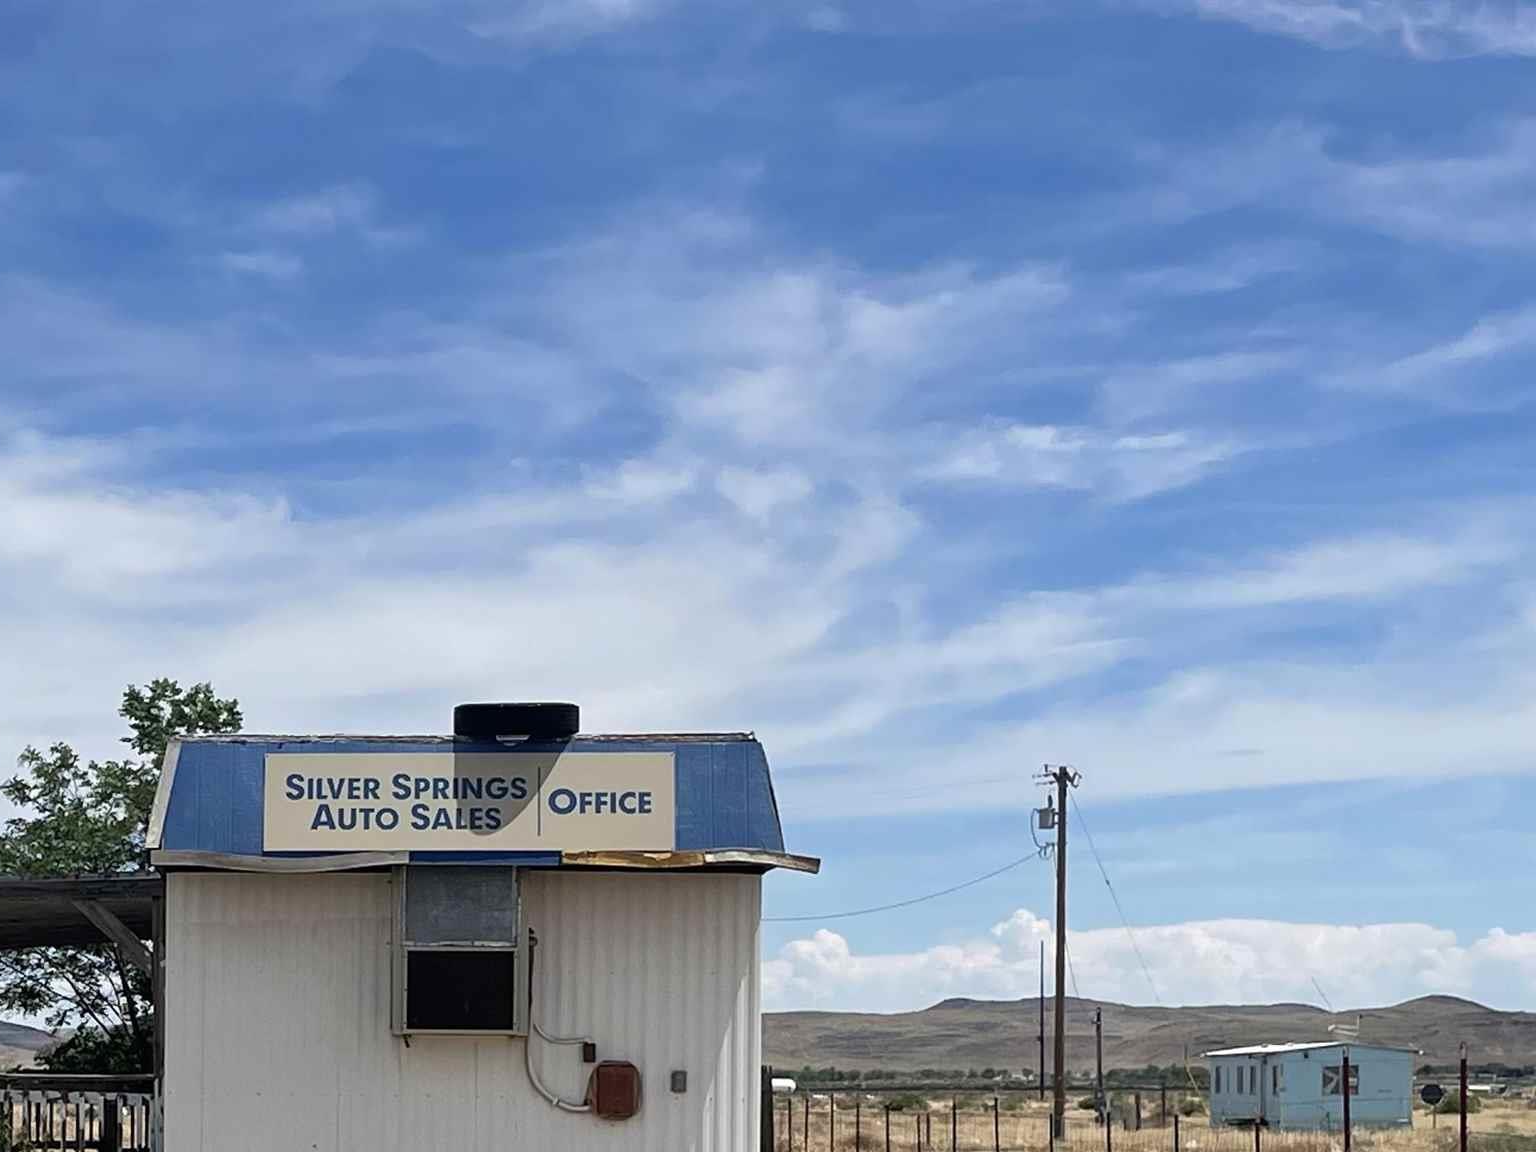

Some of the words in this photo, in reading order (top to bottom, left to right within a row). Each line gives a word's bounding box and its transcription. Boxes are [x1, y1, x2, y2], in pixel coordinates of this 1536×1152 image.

[285, 773, 381, 801] SILVER
[391, 773, 528, 801] SPRINGS
[548, 788, 652, 814] OFFICE
[310, 803, 400, 830] AUTO
[410, 803, 502, 830] SALES
